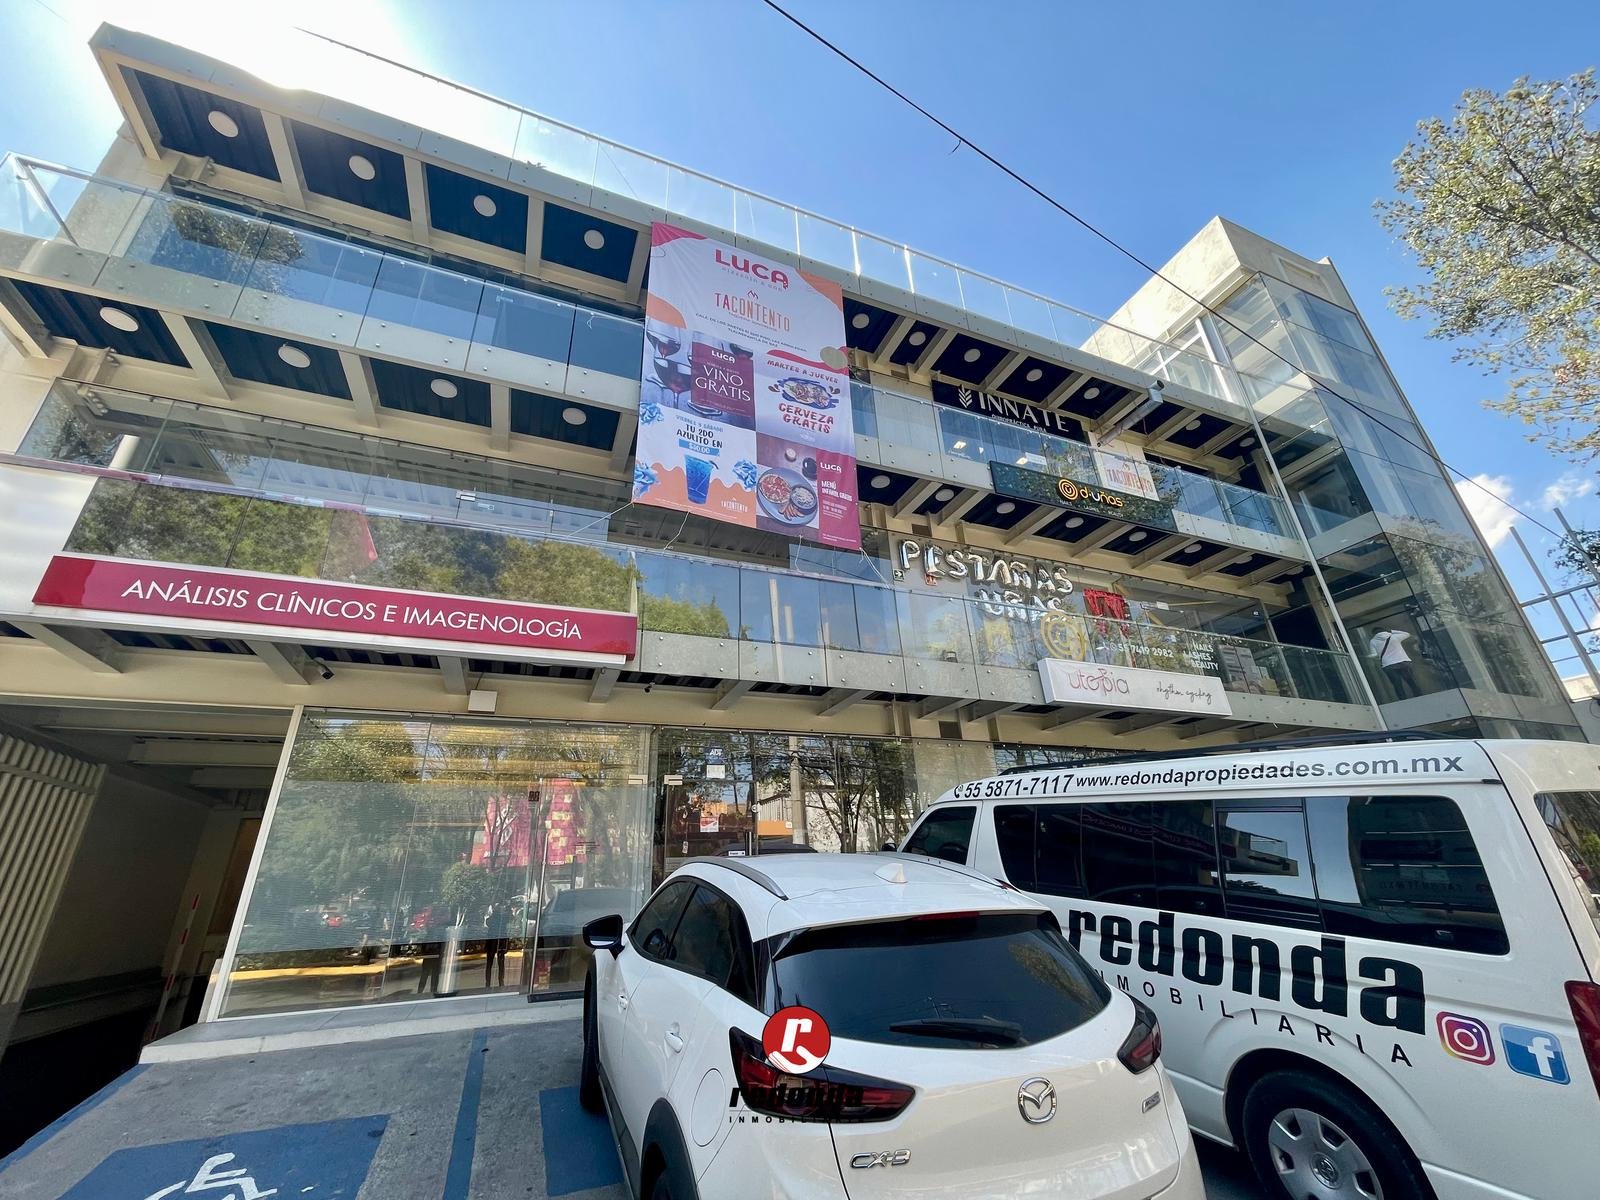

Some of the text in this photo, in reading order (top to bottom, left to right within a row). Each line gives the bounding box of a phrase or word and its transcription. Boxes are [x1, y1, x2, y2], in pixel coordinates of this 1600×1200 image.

[715, 249, 789, 290] LUCA
[715, 292, 791, 332] TACONTENTO
[711, 349, 736, 364] LUCA
[703, 365, 744, 387] VINO
[767, 360, 800, 373] MARTES
[809, 372, 839, 384] JUEVES
[695, 377, 751, 402] GRATIS
[779, 402, 834, 425] CERVEZA
[978, 391, 1069, 432] INNATE
[685, 424, 714, 439] TU 2DO
[783, 413, 831, 434] GRATIS
[676, 429, 723, 449] AZULITO EN
[820, 462, 842, 473] LUCA
[121, 579, 582, 640] ANÁLISIS CLÍNICOS E IMAGENOLOGÍA
[1118, 644, 1128, 652] 55
[1152, 648, 1174, 658] 2982
[1193, 641, 1214, 653] NAILS
[1190, 661, 1219, 672] BEAUTY
[1068, 668, 1130, 696] utopia
[964, 755, 1465, 798] 55 5871-7117 www.redondapropiedades.com.mx
[1068, 909, 1427, 1036] redonda
[850, 1149, 911, 1168] CX-3
